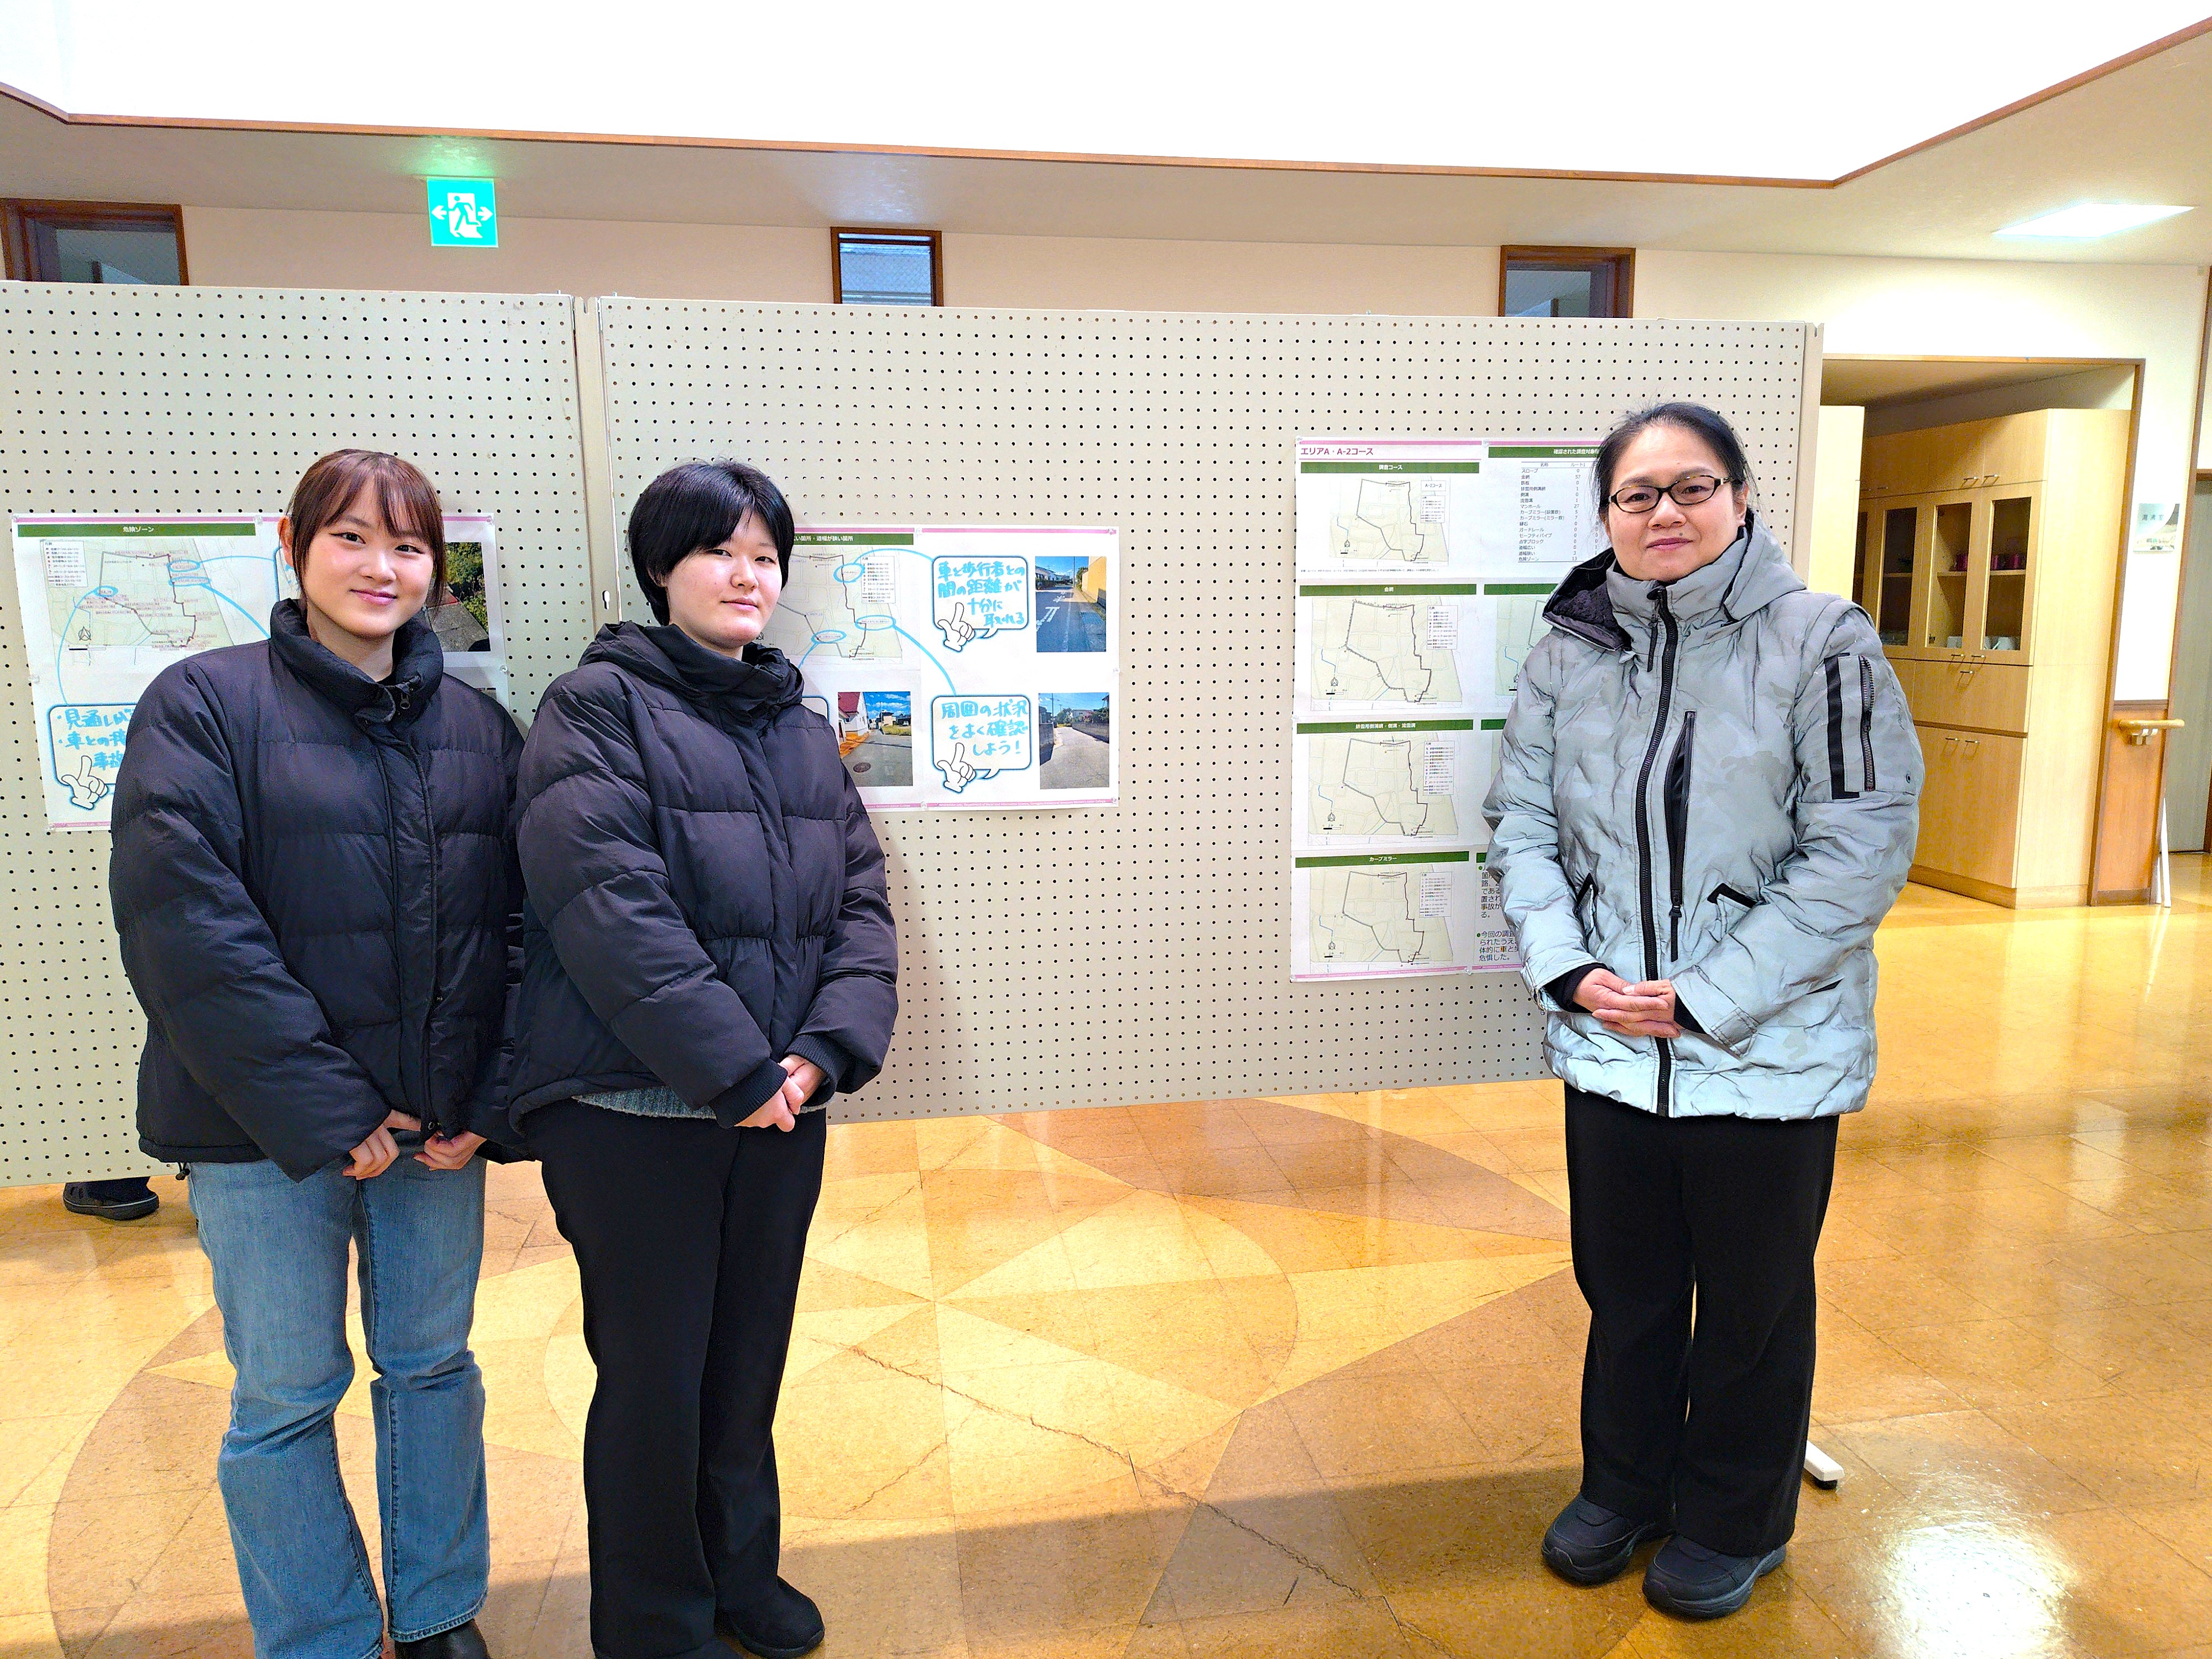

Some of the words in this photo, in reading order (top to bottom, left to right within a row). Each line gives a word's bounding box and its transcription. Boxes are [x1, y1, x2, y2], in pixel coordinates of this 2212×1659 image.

[1301, 447, 1374, 456] エリアA・A-2コース
[938, 561, 1025, 581] 車と歩行者との
[938, 577, 1022, 598] 間の距離が
[967, 598, 1003, 615] 十分に
[984, 612, 1024, 628] 取れる
[941, 699, 1028, 719] 周囲の状況
[949, 719, 1028, 740] をよく確認
